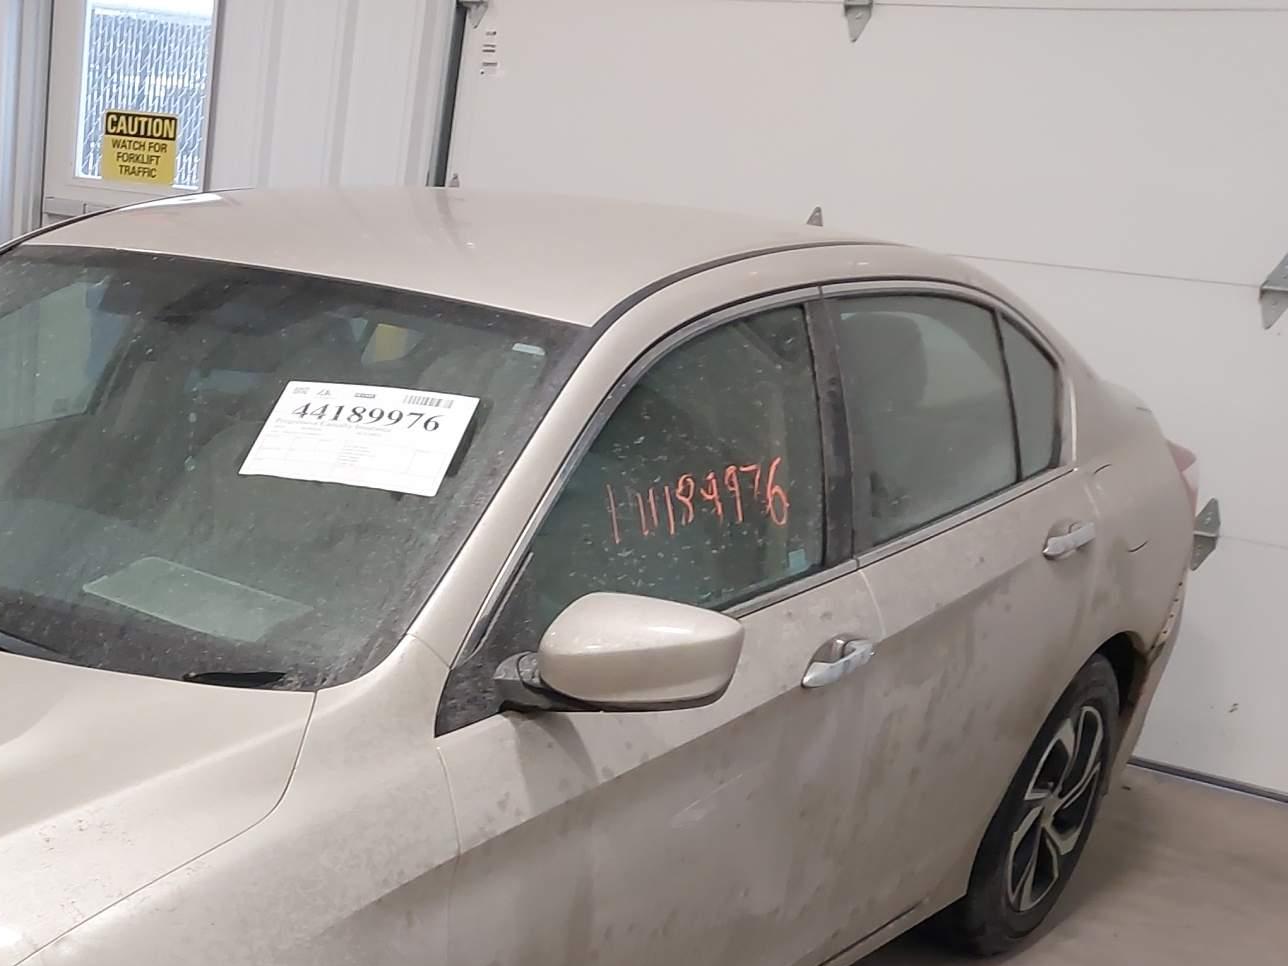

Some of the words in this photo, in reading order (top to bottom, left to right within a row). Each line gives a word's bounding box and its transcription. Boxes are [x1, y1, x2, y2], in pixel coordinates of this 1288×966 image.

[107, 114, 176, 139] CAUTION
[112, 139, 146, 151] WATCH
[148, 142, 168, 153] FOR
[116, 152, 161, 165] FORKLIFT
[119, 165, 157, 178] TRAFFIC
[291, 402, 444, 432] 44189976
